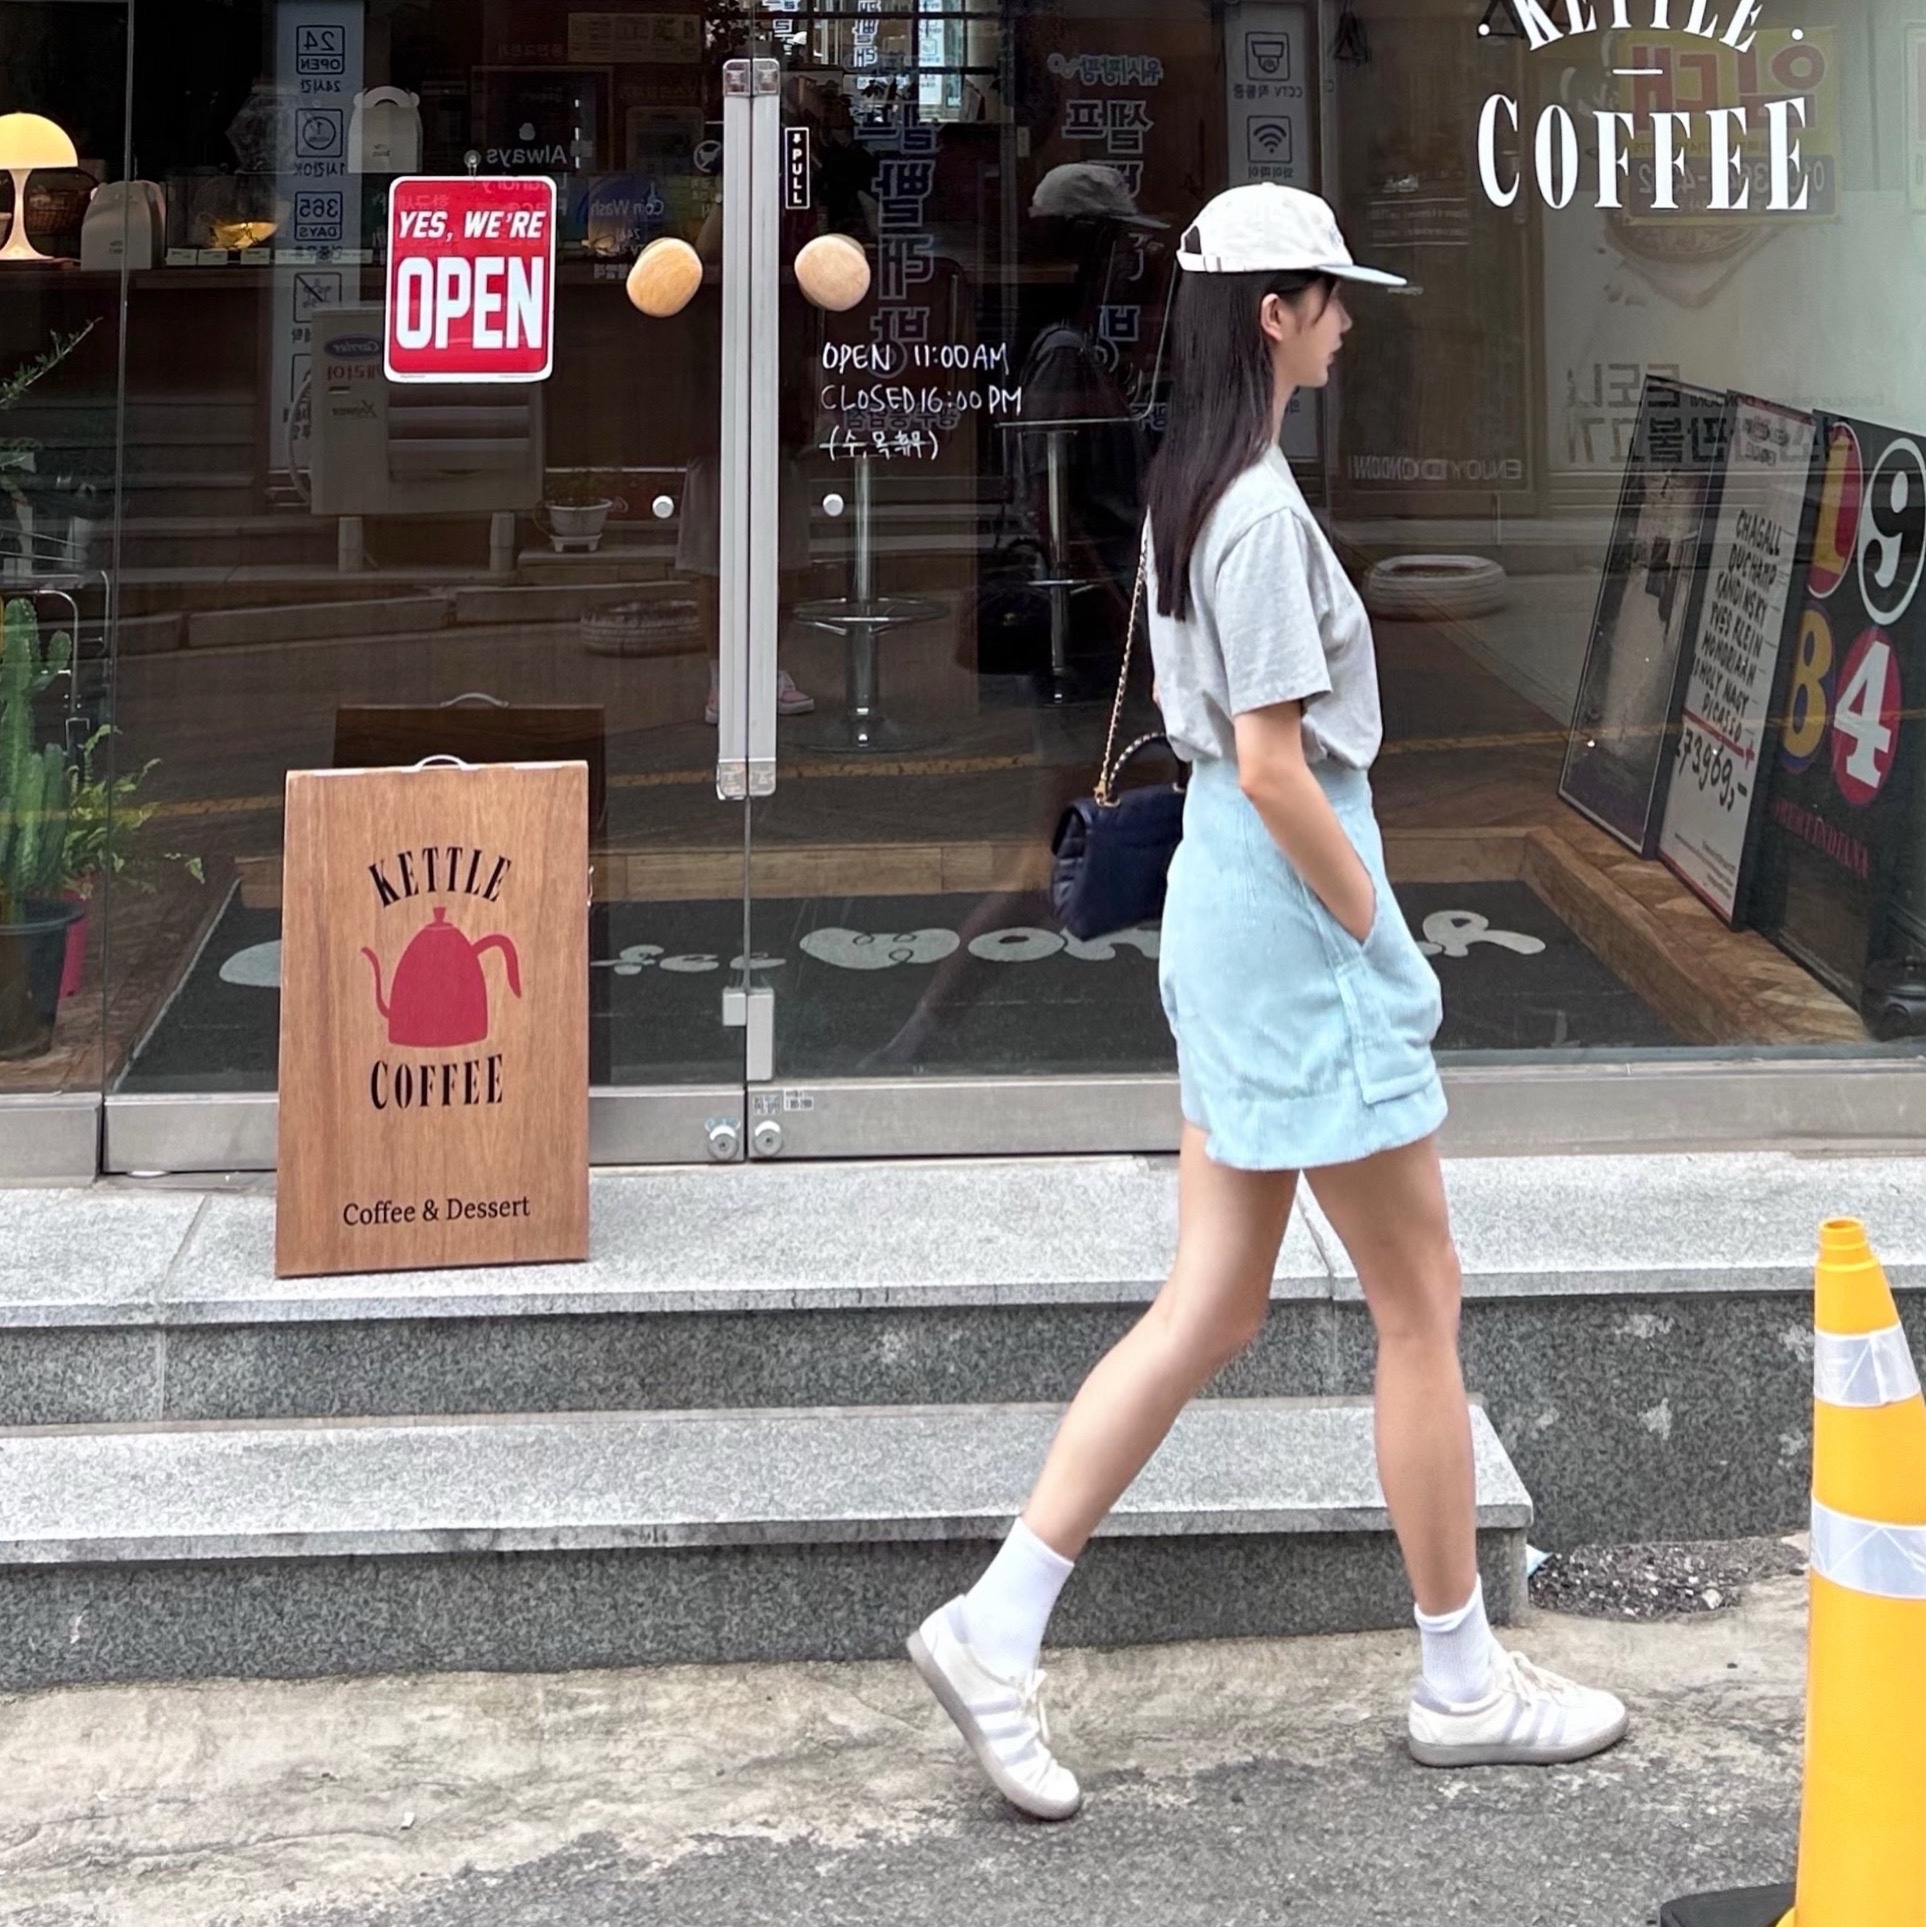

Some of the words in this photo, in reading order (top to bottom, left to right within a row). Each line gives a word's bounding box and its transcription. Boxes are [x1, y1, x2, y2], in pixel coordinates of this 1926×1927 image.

[1477, 92, 1811, 210] COFFEE
[791, 148, 804, 205] PULL
[398, 211, 456, 240] YES,
[464, 211, 546, 238] WE'RE
[395, 256, 544, 351] OPEN
[821, 341, 891, 374] OPEN
[987, 383, 1024, 416] PM
[1735, 508, 1782, 556] CHAGALL
[1728, 543, 1777, 592] DUCHAMP
[1715, 571, 1769, 628] KANDINSKY
[1731, 616, 1764, 659] KLEIN
[368, 845, 513, 908] KETTLE
[369, 1052, 505, 1111] COFFEE
[342, 1197, 417, 1227] Coffee
[422, 1198, 440, 1221] &
[445, 1195, 531, 1222] Dessert
